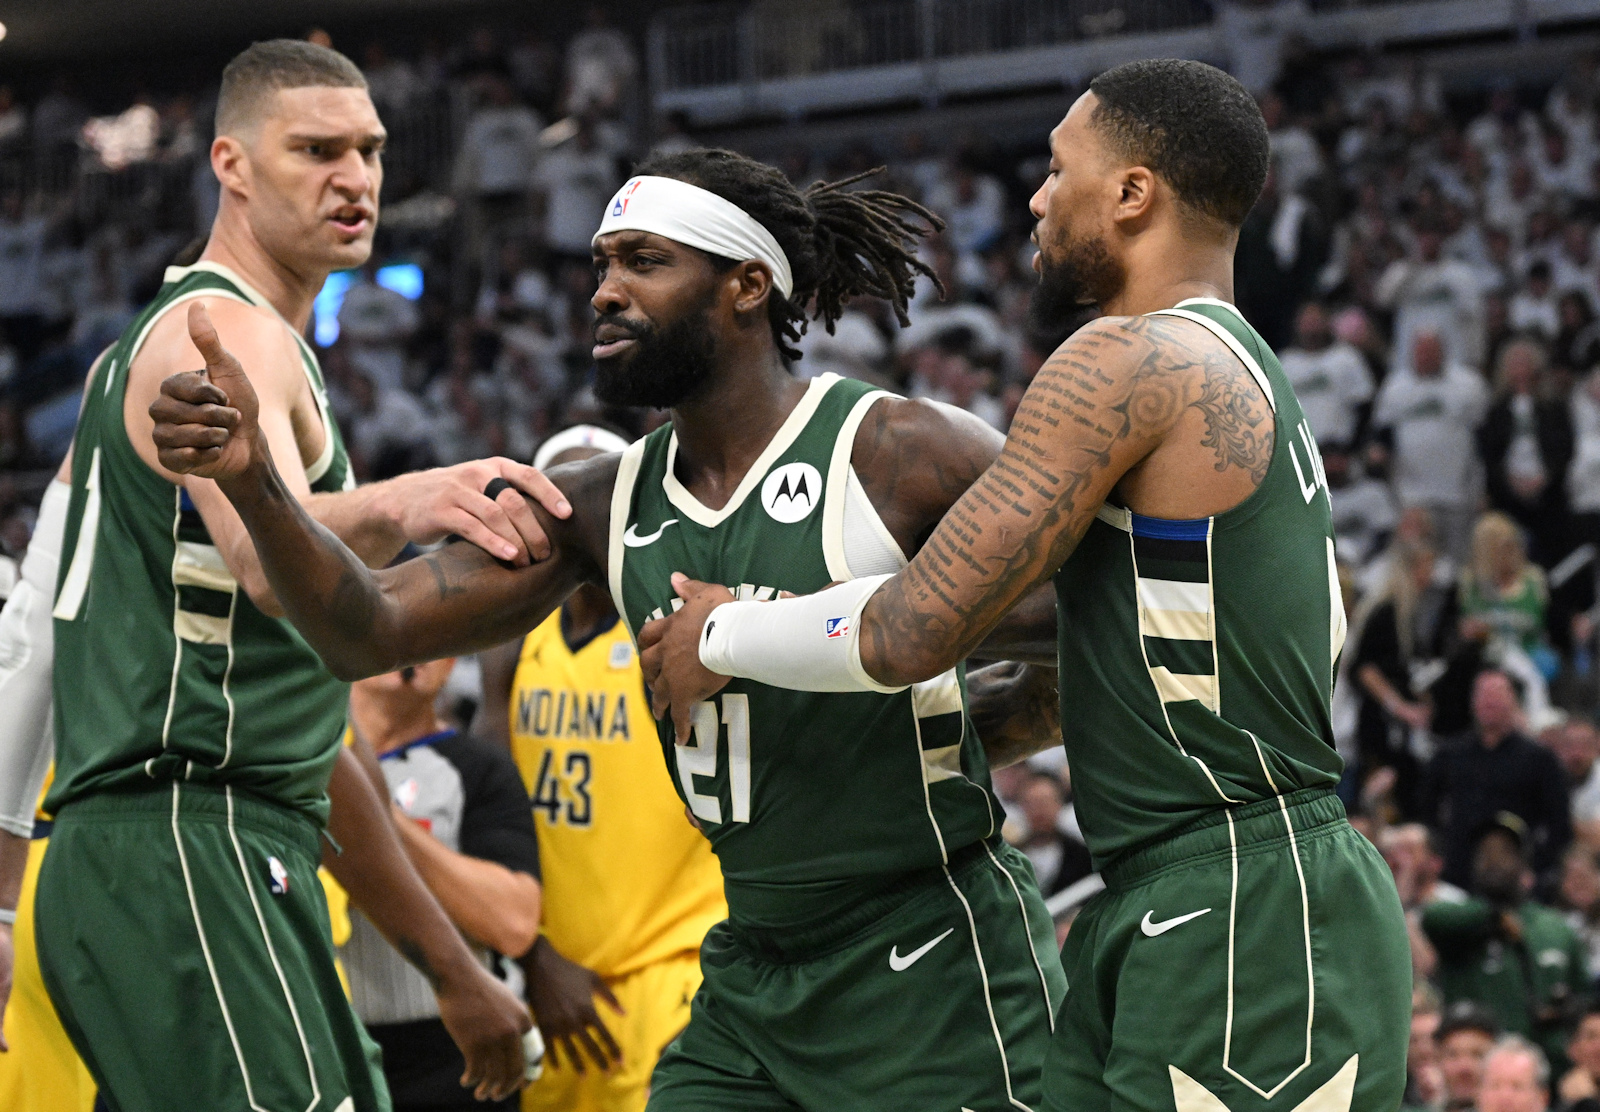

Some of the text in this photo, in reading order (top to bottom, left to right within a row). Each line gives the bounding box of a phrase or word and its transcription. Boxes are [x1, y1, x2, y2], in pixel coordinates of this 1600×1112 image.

[515, 688, 630, 742] NDIANA
[531, 748, 593, 827] 43
[674, 692, 750, 825] 21
